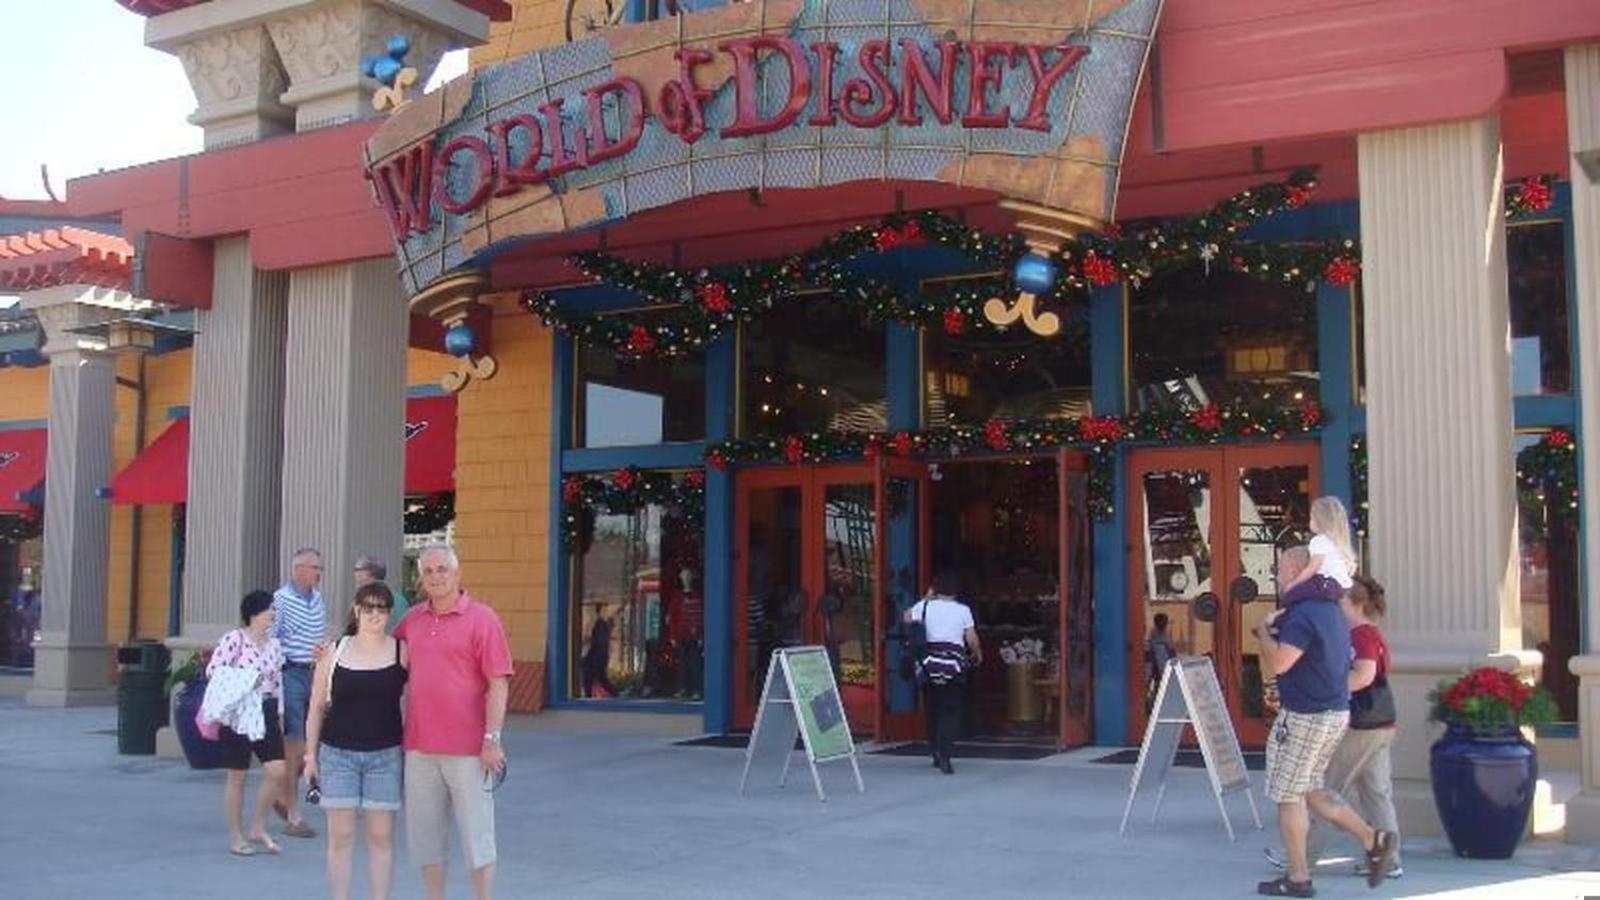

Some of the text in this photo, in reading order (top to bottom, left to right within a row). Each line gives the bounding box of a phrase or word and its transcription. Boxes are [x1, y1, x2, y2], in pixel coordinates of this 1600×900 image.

[366, 37, 1090, 242] WORLD of DISNEY
